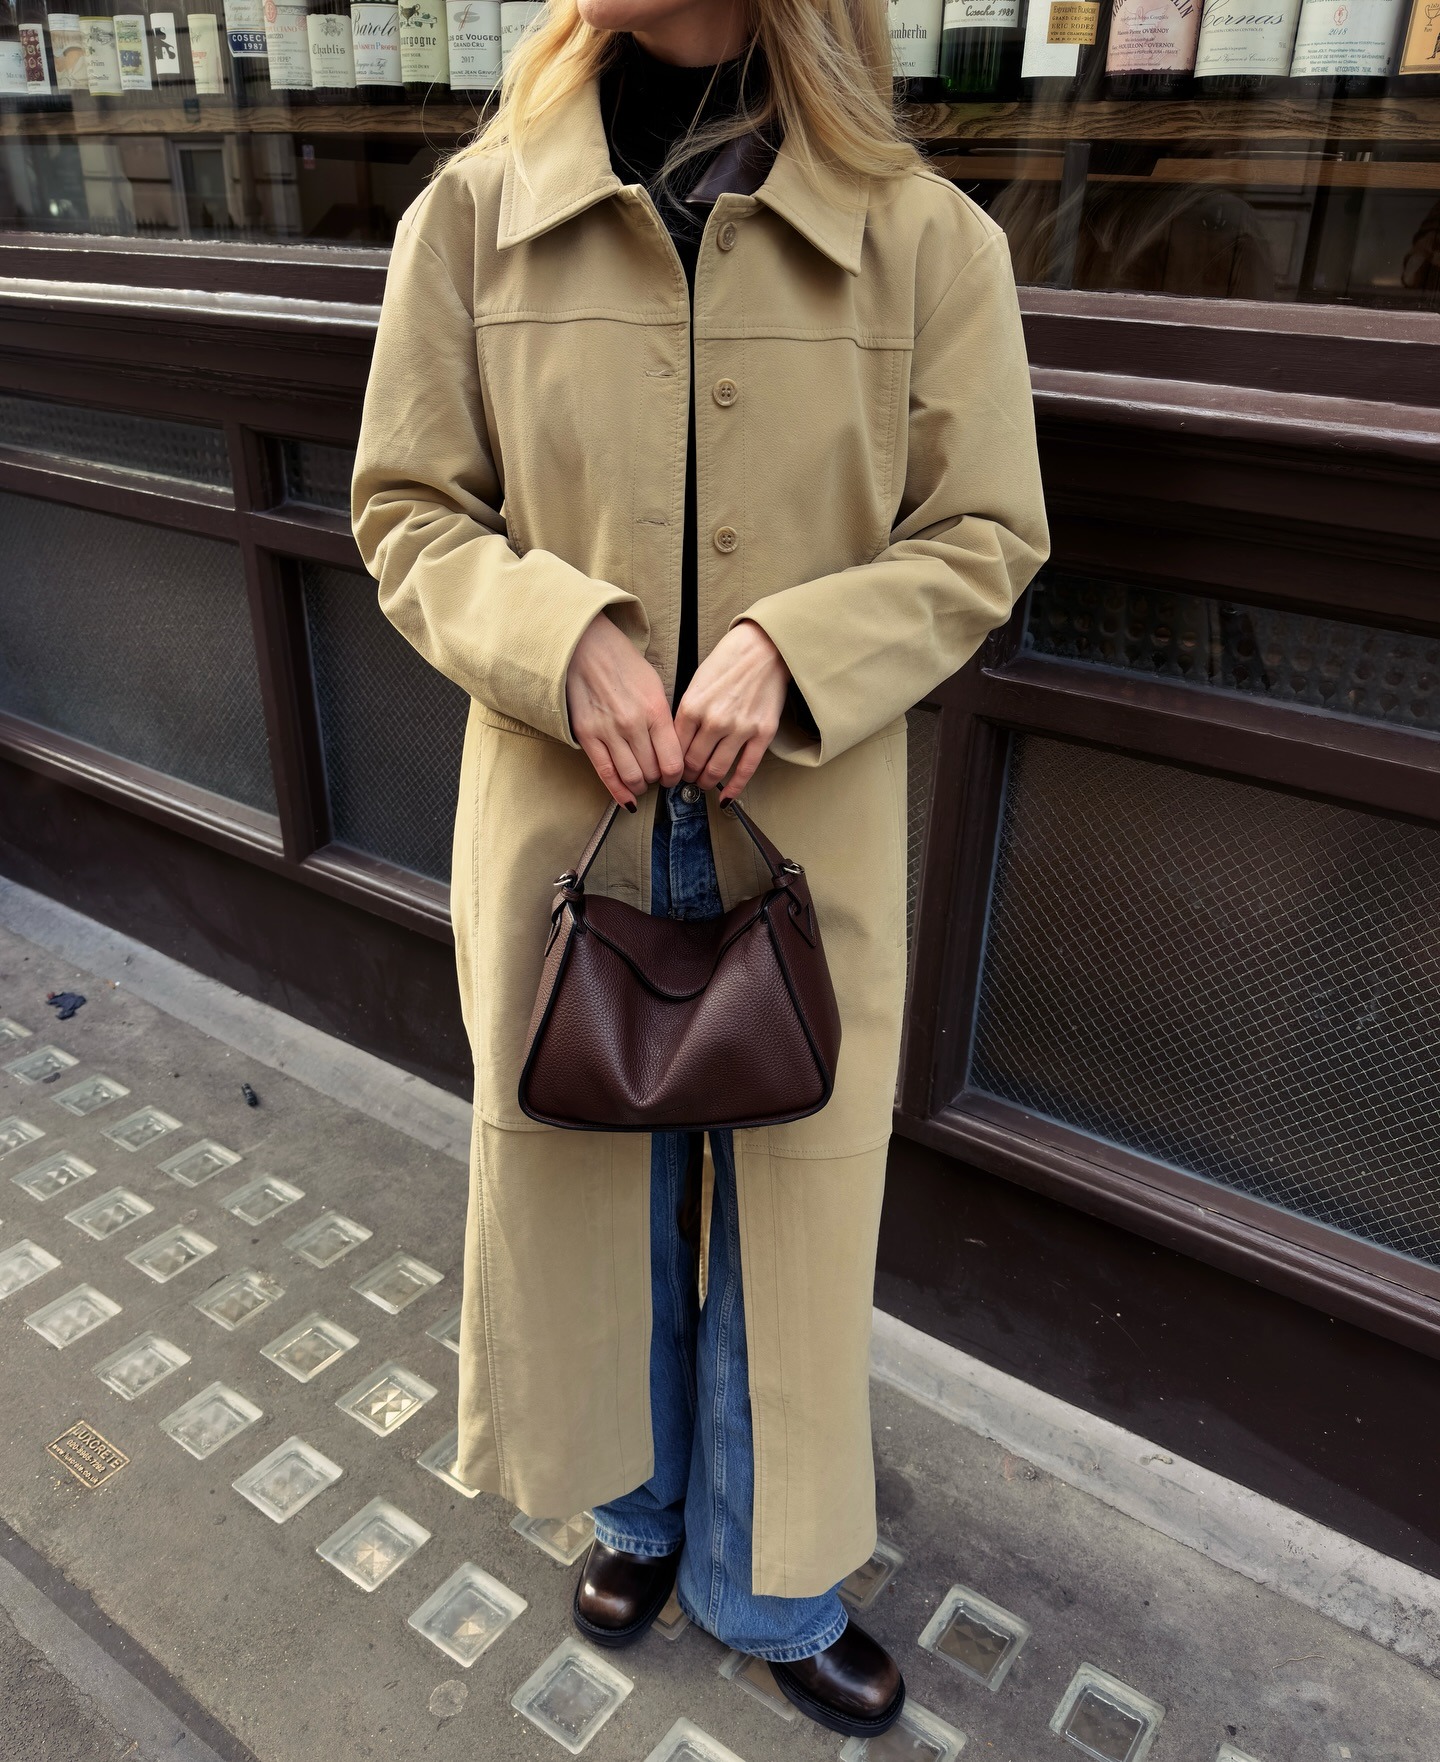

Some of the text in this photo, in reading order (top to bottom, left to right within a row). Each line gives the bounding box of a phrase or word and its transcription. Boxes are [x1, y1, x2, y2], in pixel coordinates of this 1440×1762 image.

[965, 4, 1015, 17] Cosecha 1989
[1200, 0, 1284, 29] Cornas
[352, 8, 399, 37] Barolo
[1070, 22, 1095, 30] RODEZ
[1141, 27, 1170, 35] OVERNOY
[1328, 27, 1348, 36] 2018
[312, 43, 346, 57] Chablis
[461, 55, 475, 64] 2017
[71, 1427, 123, 1468] LUXCRETE
